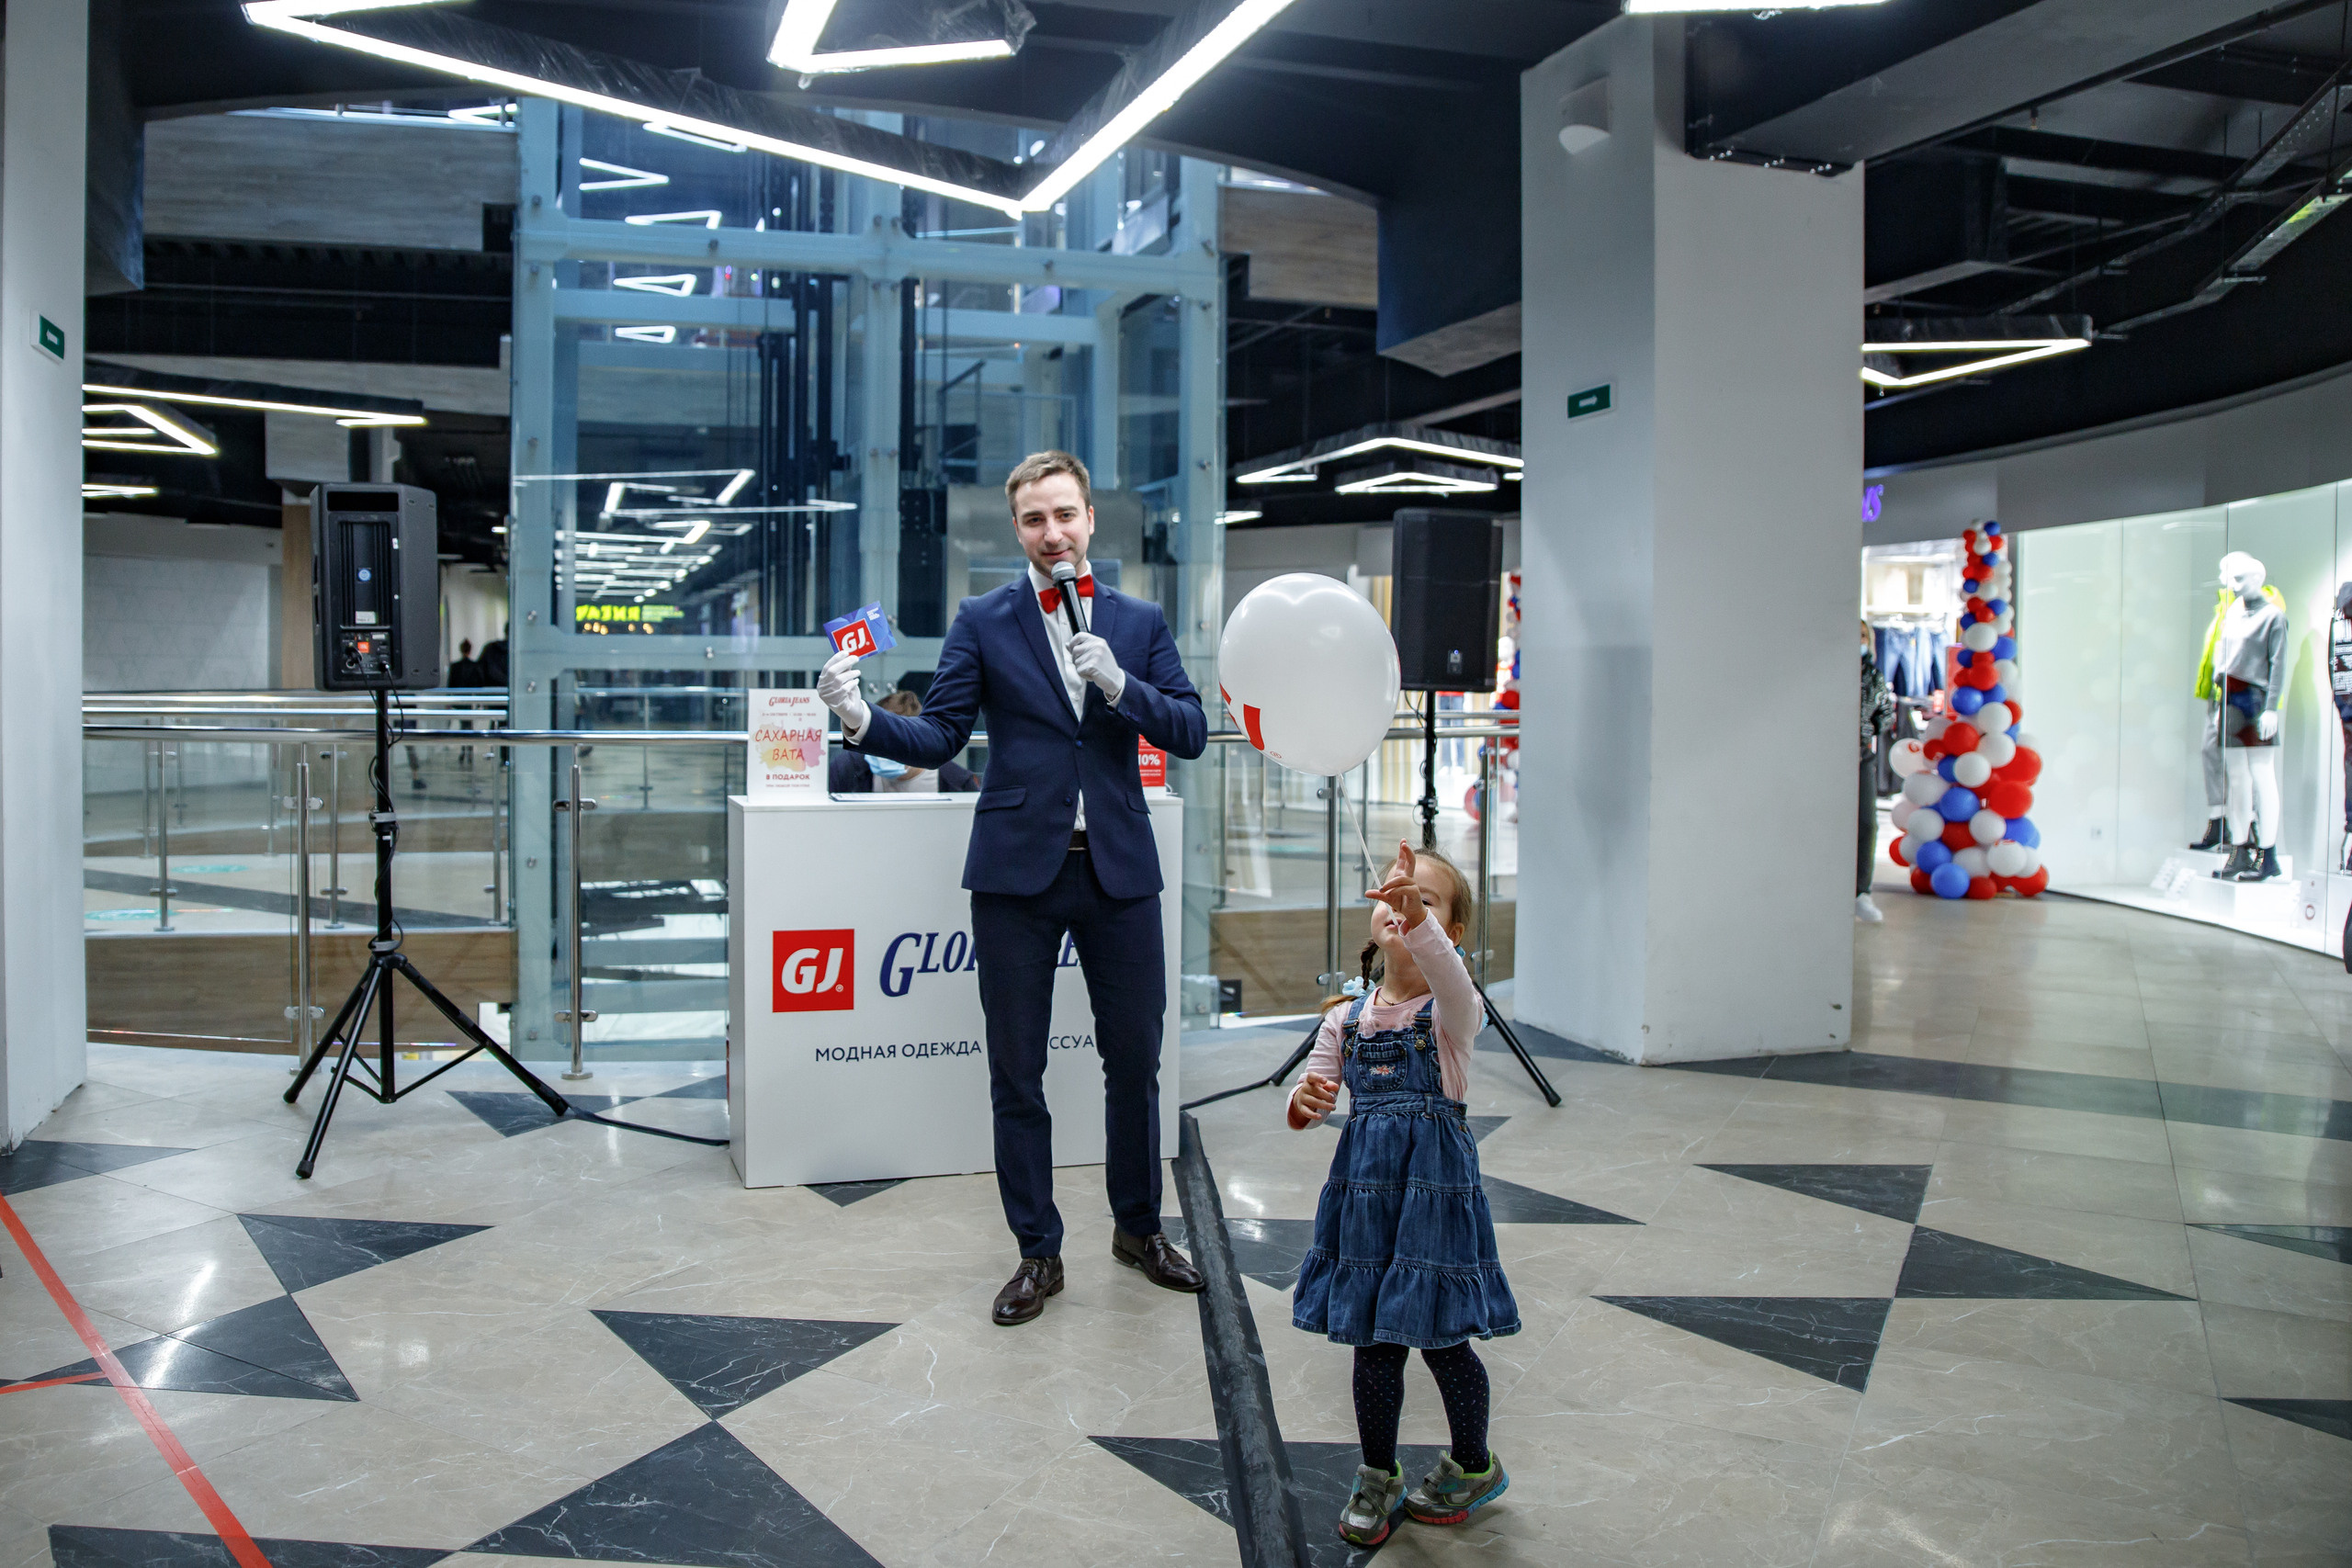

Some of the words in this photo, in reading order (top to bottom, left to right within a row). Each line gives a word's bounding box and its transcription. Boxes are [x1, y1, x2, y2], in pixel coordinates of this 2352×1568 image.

[841, 626, 866, 653] GJ
[754, 728, 822, 742] САХАРНАЯ
[772, 748, 805, 761] ВАТА
[781, 947, 844, 995] GJ
[815, 1043, 897, 1062] МОДНАЯ
[901, 1040, 982, 1059] ОДЕЖДА
[1048, 1034, 1095, 1051] ССУА
